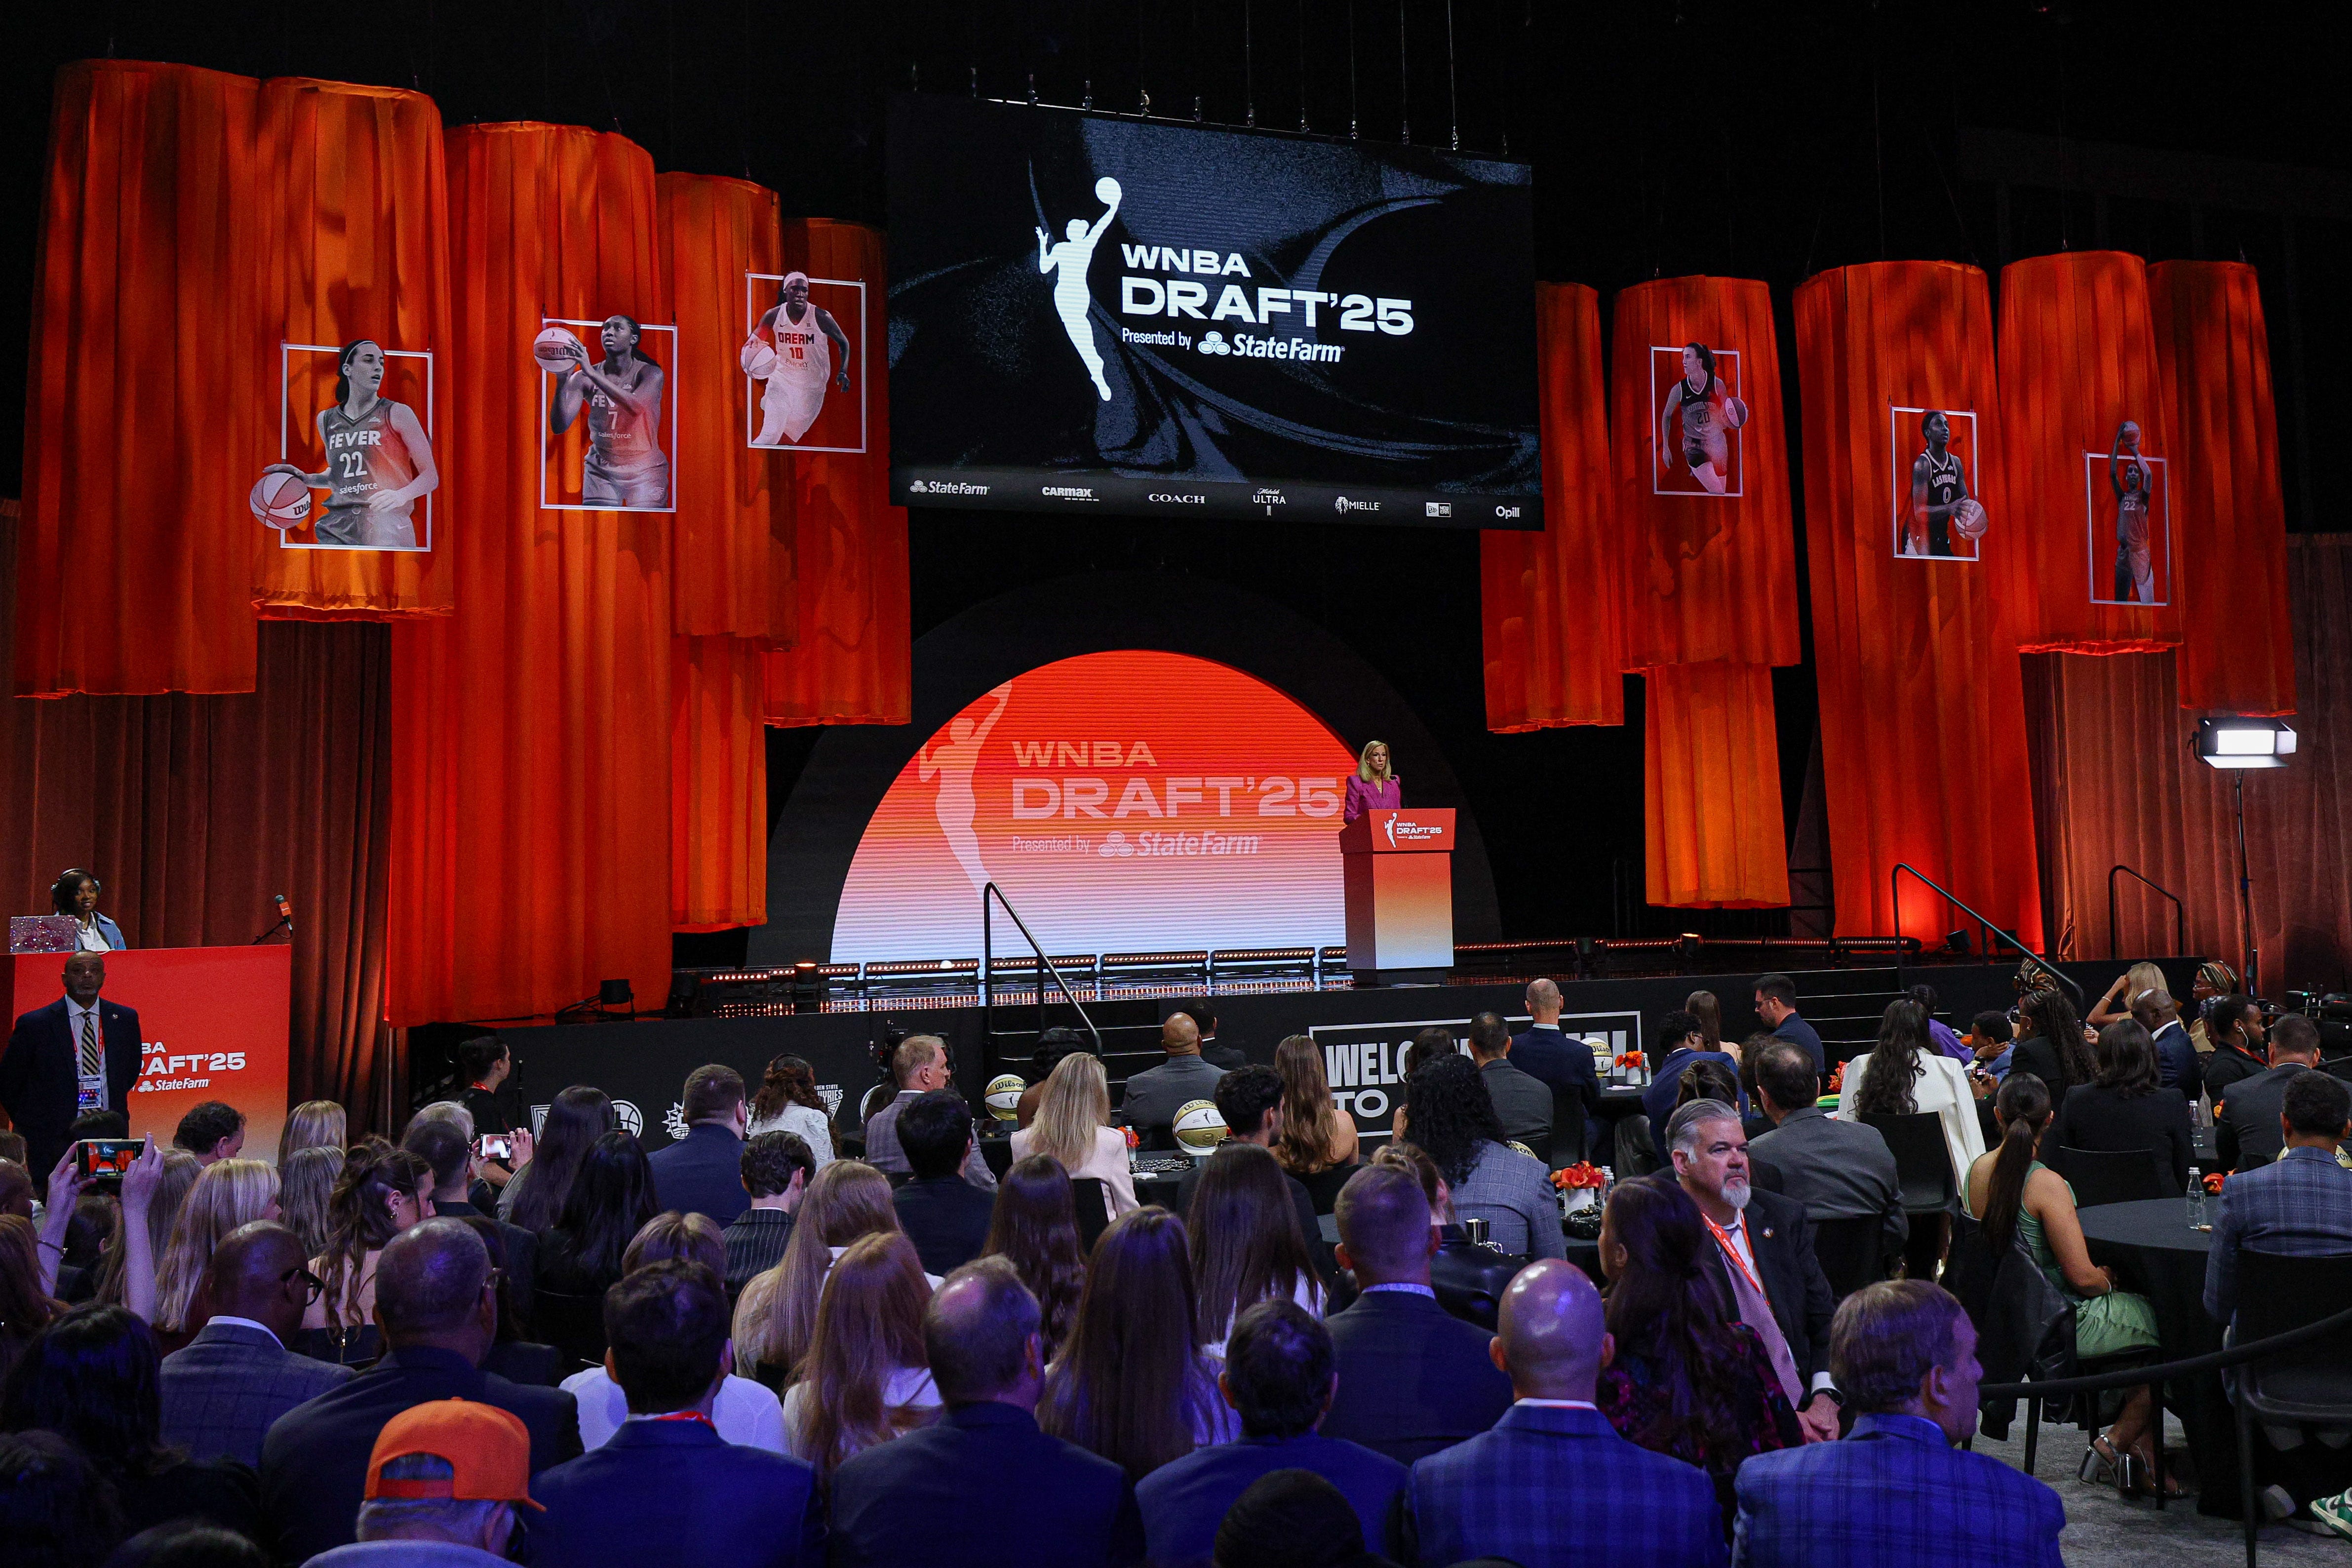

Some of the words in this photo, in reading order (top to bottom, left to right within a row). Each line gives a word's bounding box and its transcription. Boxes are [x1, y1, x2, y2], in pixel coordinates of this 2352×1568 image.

[1121, 243, 1252, 277] WNBA
[1121, 276, 1414, 335] DRAFT'25
[778, 332, 815, 345] DREAM
[1122, 327, 1175, 346] Presented
[1178, 331, 1191, 350] by
[789, 347, 803, 359] 10
[591, 394, 616, 407] FEV
[608, 411, 618, 430] 7
[1696, 411, 1710, 424] 20
[329, 430, 382, 450] FEVER
[339, 451, 368, 478] 22
[339, 482, 378, 495] salesforce
[1943, 487, 1951, 504] 0
[1148, 493, 1206, 505] COACH
[1253, 495, 1287, 504] ULTRA
[1349, 501, 1379, 511] MIELLE
[2124, 501, 2135, 510] 22
[292, 501, 311, 515] Wil
[1495, 506, 1520, 519] Opill
[1011, 741, 1158, 767] WNBA
[1012, 776, 1340, 819] DRAFT'25
[1012, 834, 1072, 852] Presented
[1076, 834, 1091, 855] by
[142, 1042, 167, 1054] BA
[1331, 1089, 1388, 1118] TO
